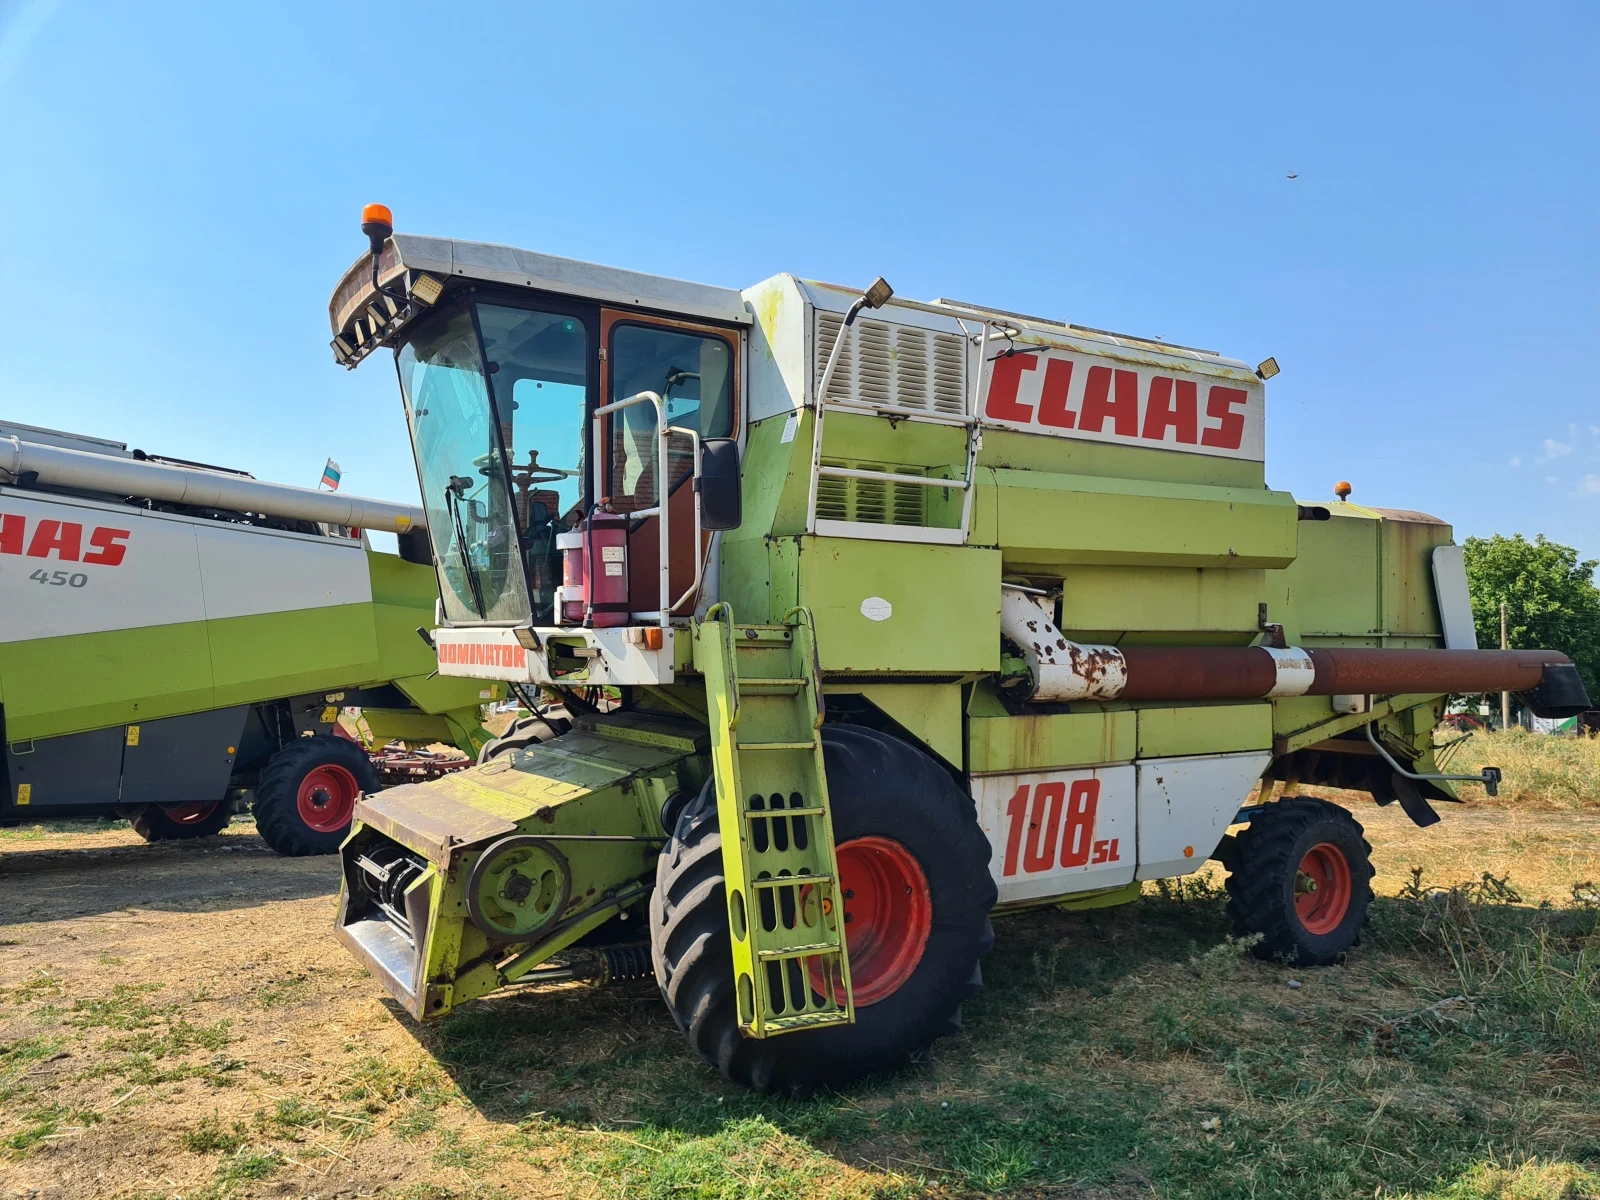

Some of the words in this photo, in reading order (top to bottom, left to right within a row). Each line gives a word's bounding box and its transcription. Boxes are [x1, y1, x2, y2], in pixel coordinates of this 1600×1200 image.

[985, 350, 1248, 450] CLAAS
[29, 568, 88, 588] 450
[439, 643, 526, 668] DOMINATOR
[1003, 778, 1101, 877] 108
[1091, 838, 1120, 865] SL
